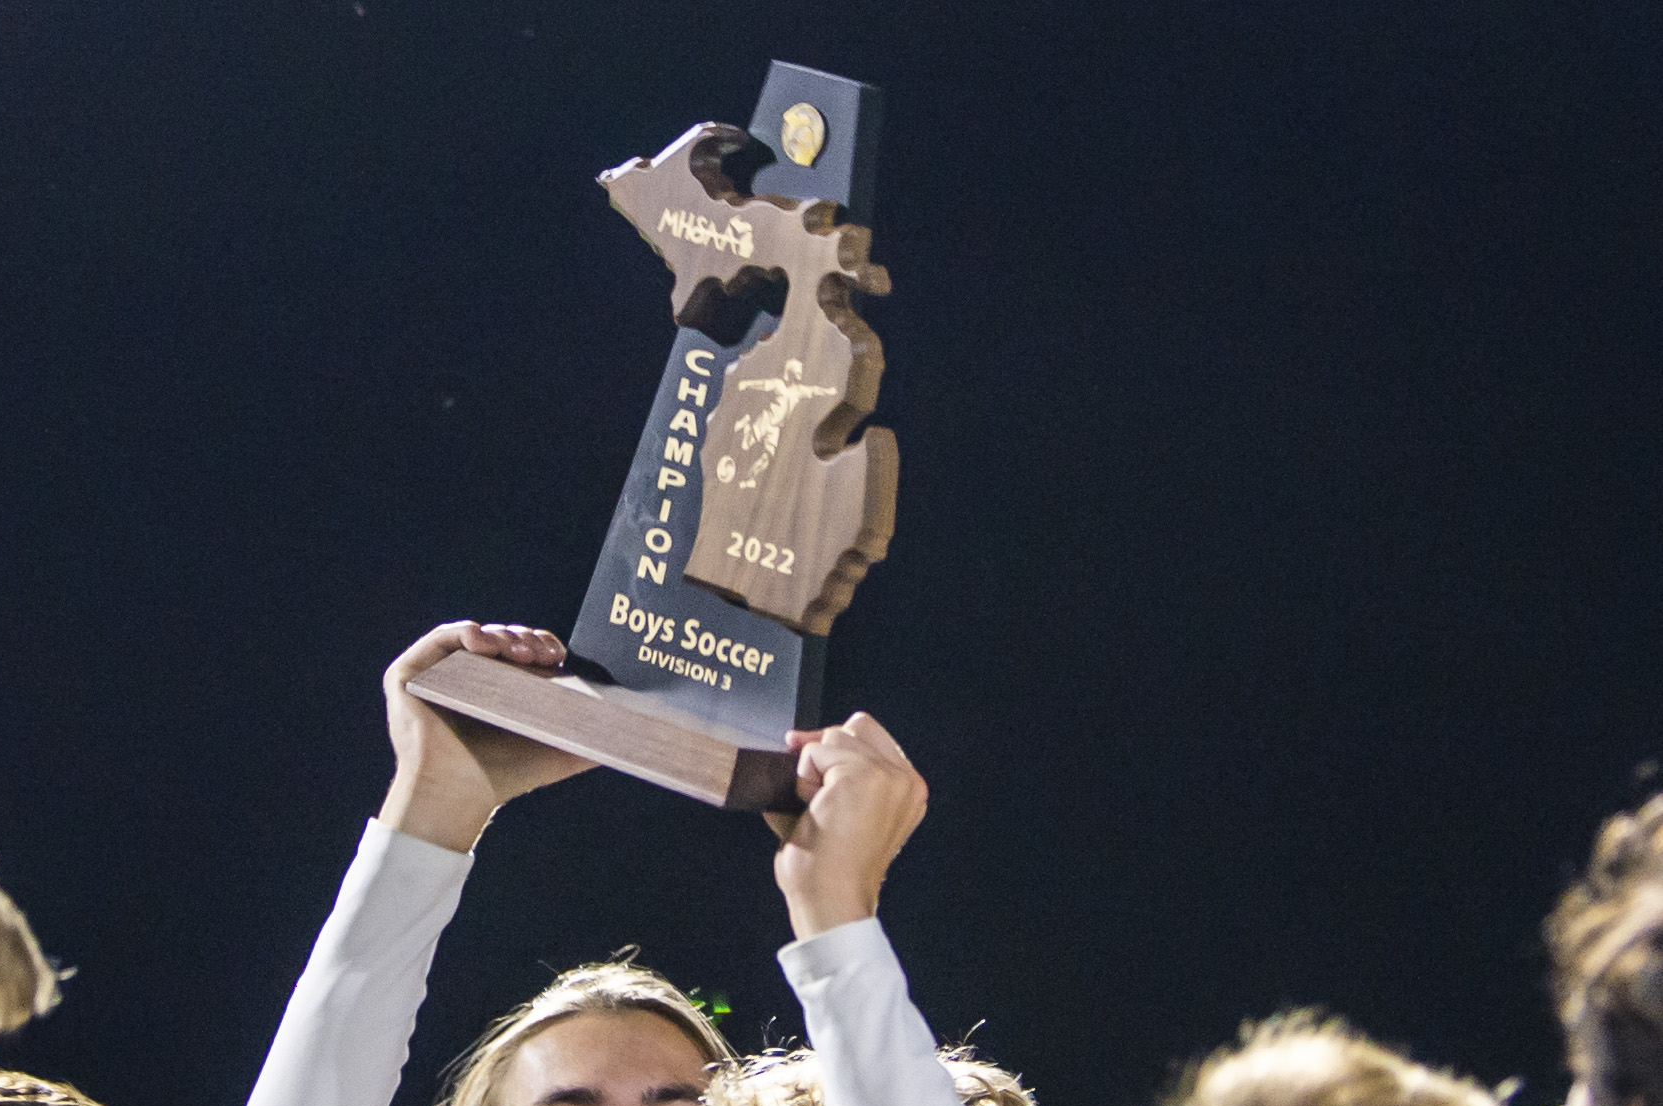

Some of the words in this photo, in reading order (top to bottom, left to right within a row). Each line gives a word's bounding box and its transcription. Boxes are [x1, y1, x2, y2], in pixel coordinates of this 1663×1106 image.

[637, 350, 715, 585] CHAMPION
[726, 532, 795, 574] 2022
[609, 593, 675, 644] Boys
[681, 618, 774, 676] Soccer
[638, 645, 718, 686] DIVISION
[721, 673, 732, 691] 3
